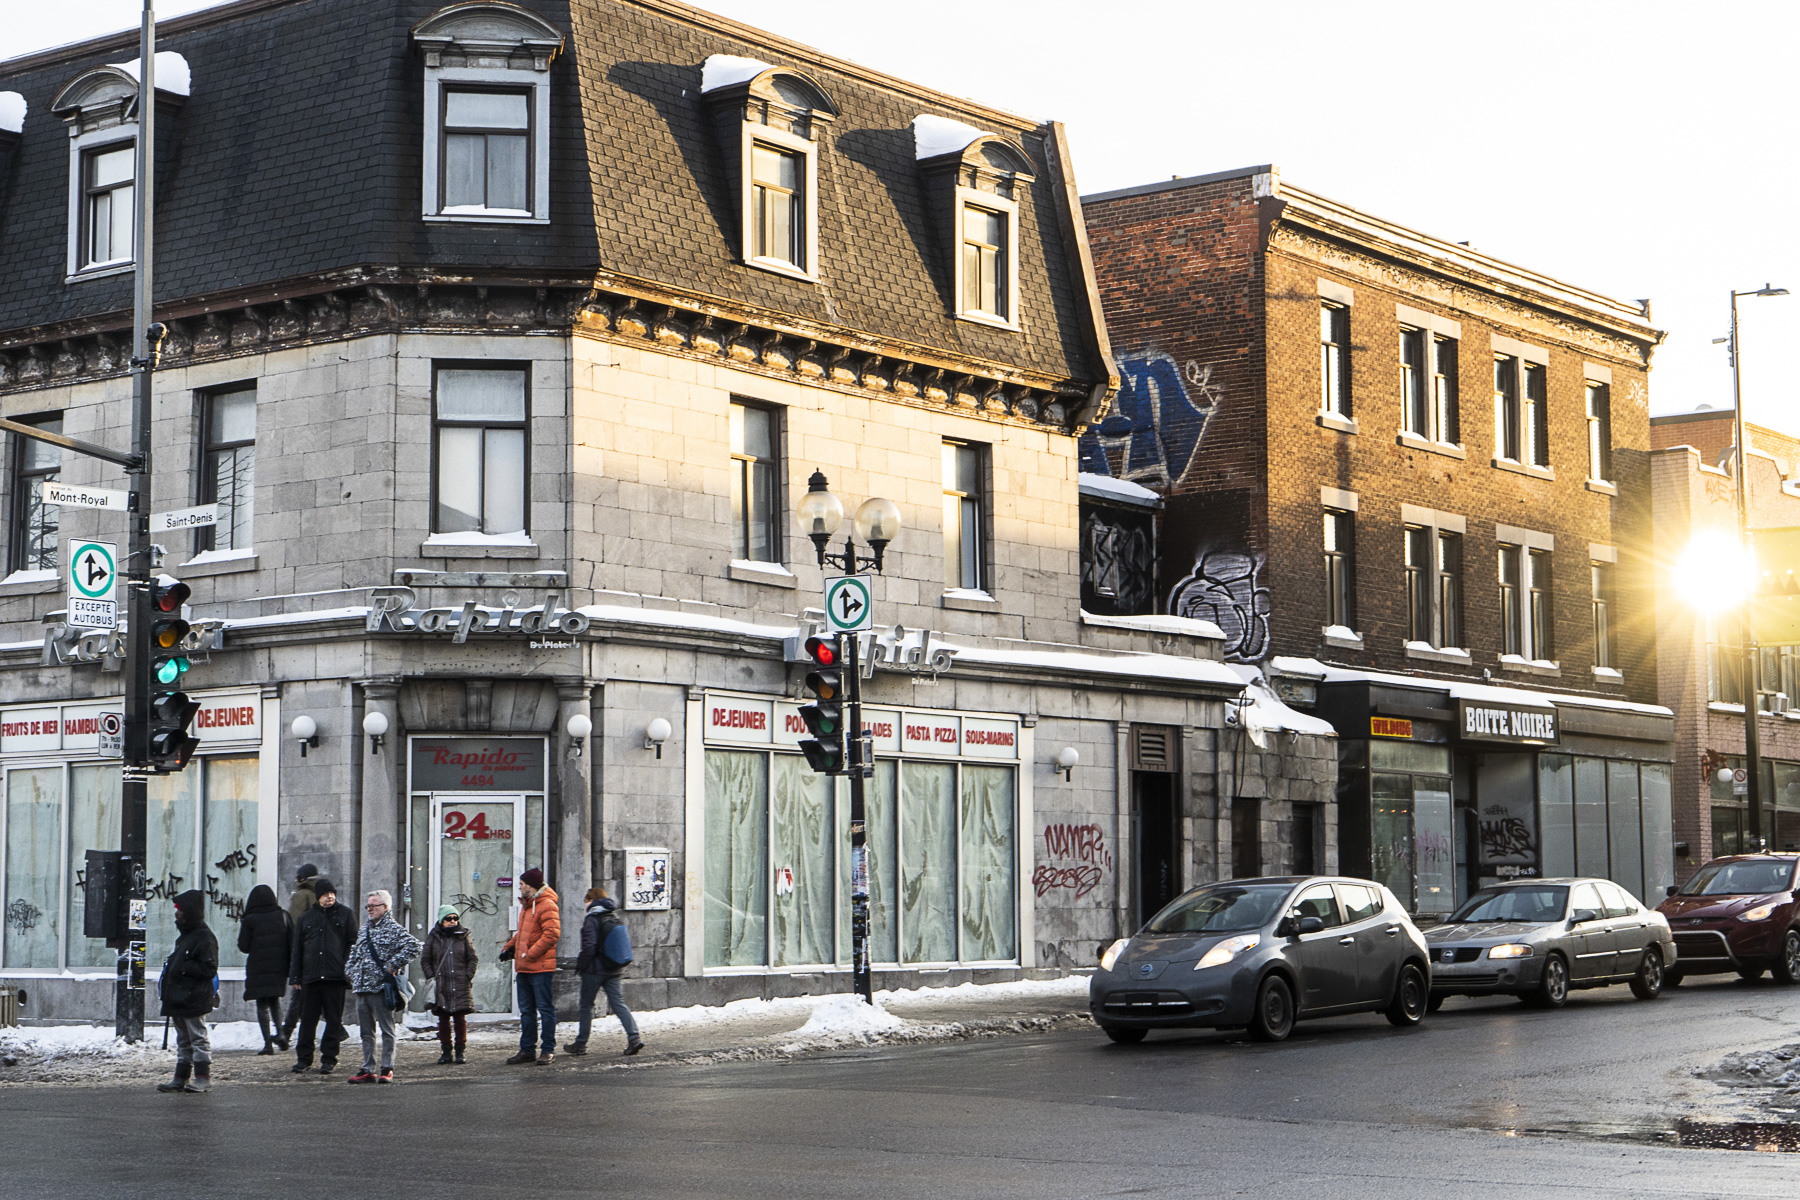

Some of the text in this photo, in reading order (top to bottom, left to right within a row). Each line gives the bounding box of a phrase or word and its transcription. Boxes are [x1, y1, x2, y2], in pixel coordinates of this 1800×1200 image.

[50, 490, 108, 506] Mont-Royal
[166, 512, 212, 528] Saint-Denis
[75, 602, 111, 613] EXCEPTÉ
[366, 586, 589, 643] Rapido
[74, 614, 112, 625] AUTOBUS
[198, 706, 254, 728] DEJEUNER
[712, 708, 766, 730] DEJEUNER
[1466, 706, 1554, 738] BOITE NOIRE
[2, 720, 58, 737] FRUITS DE MER
[64, 718, 99, 735] HAMBU
[906, 725, 957, 744] PASTA PIZZA
[966, 730, 1014, 746] SOUS-MARINS
[433, 748, 518, 770] Rapido
[461, 775, 494, 786] 4494
[445, 811, 512, 839] 24 HRS
